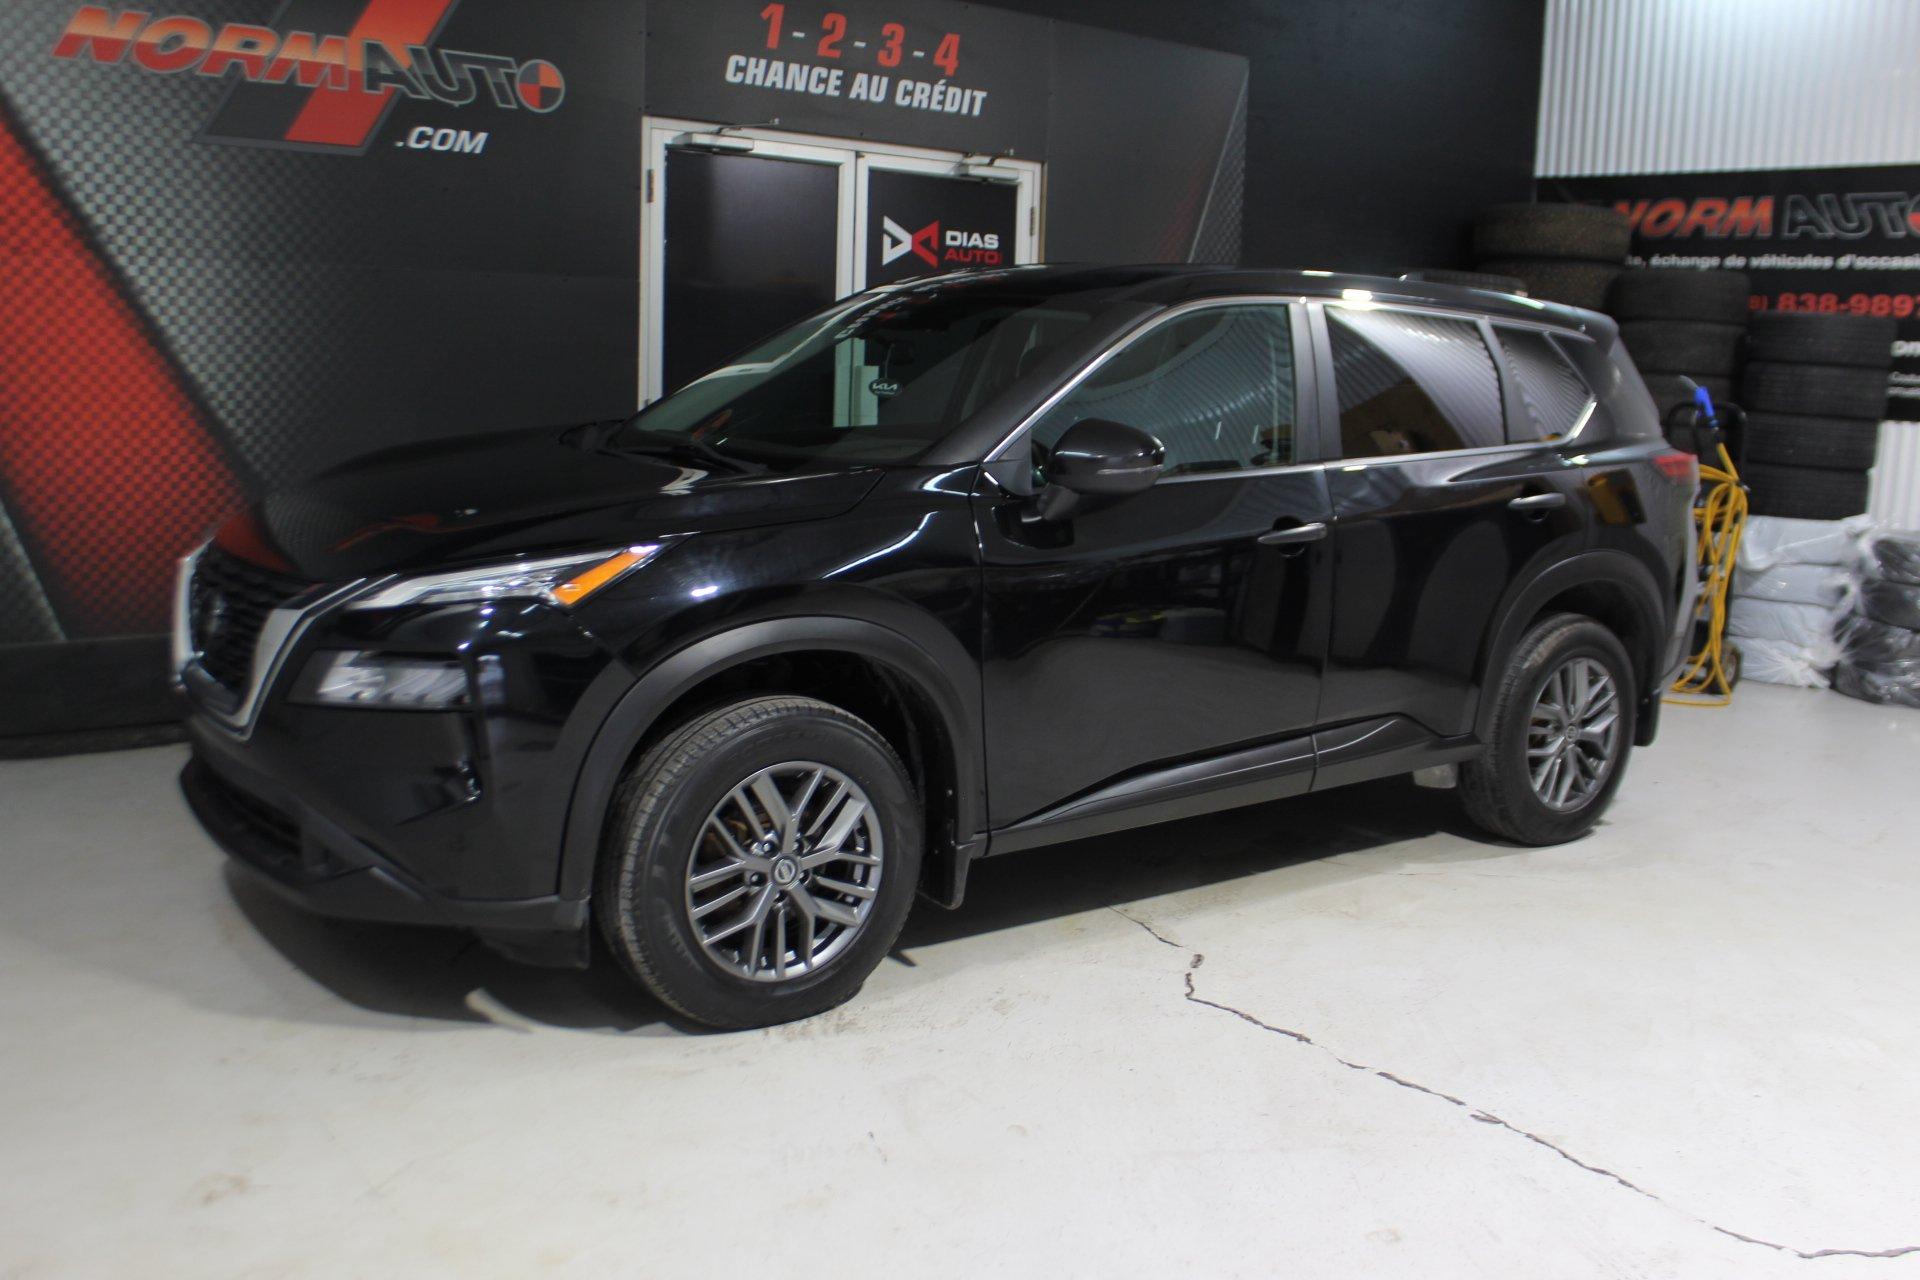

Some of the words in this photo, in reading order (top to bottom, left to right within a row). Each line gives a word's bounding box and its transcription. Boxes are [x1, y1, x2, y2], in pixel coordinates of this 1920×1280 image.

[724, 54, 844, 97] CHANCE
[849, 72, 889, 103] AU
[894, 78, 988, 117] CRÉDIT
[395, 126, 489, 154] .COM
[945, 230, 999, 250] DIAS
[944, 248, 1002, 266] AUTO
[1649, 253, 1721, 270] échange
[1723, 254, 1747, 269] de
[1777, 292, 1920, 318] 838-989
